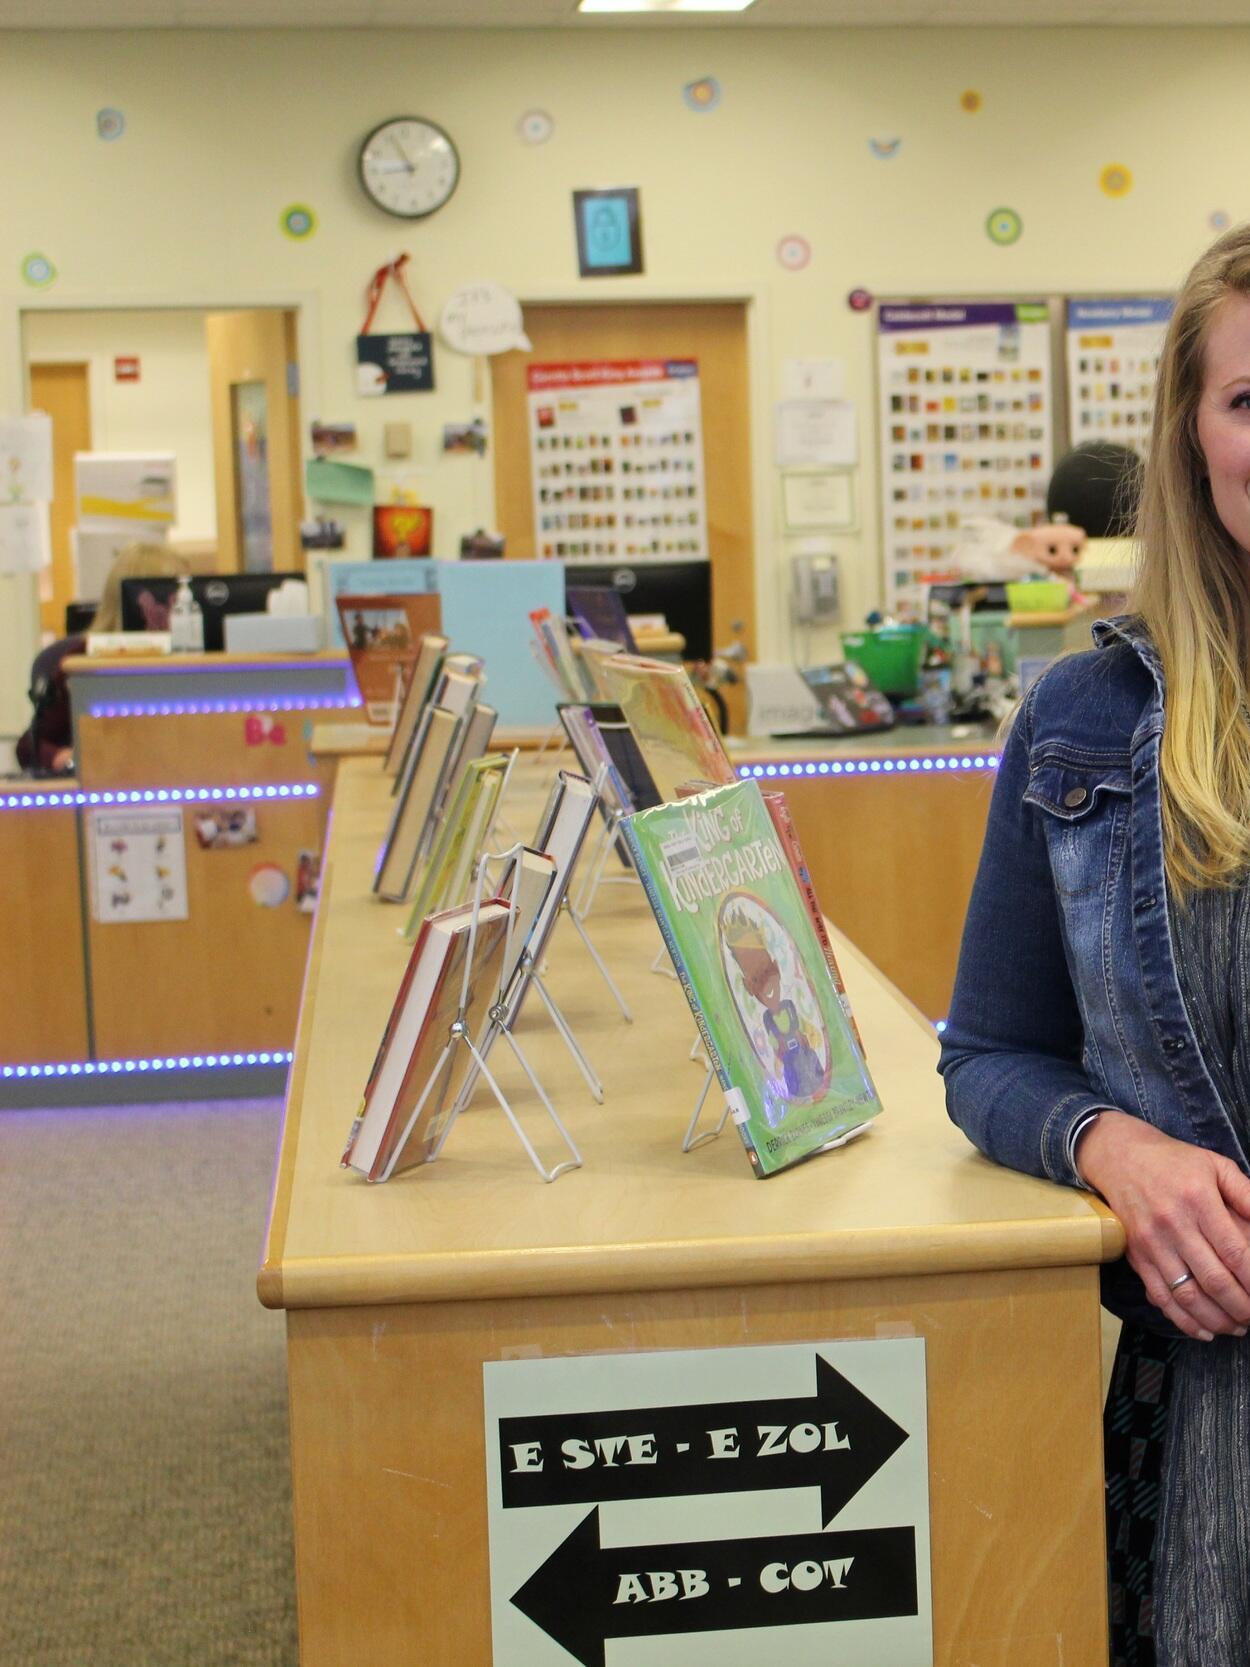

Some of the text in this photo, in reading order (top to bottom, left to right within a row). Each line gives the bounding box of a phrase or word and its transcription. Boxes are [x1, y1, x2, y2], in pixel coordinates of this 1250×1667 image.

[508, 1420, 852, 1474] E STE - E ZOL
[611, 1556, 855, 1605] ABB - COT
